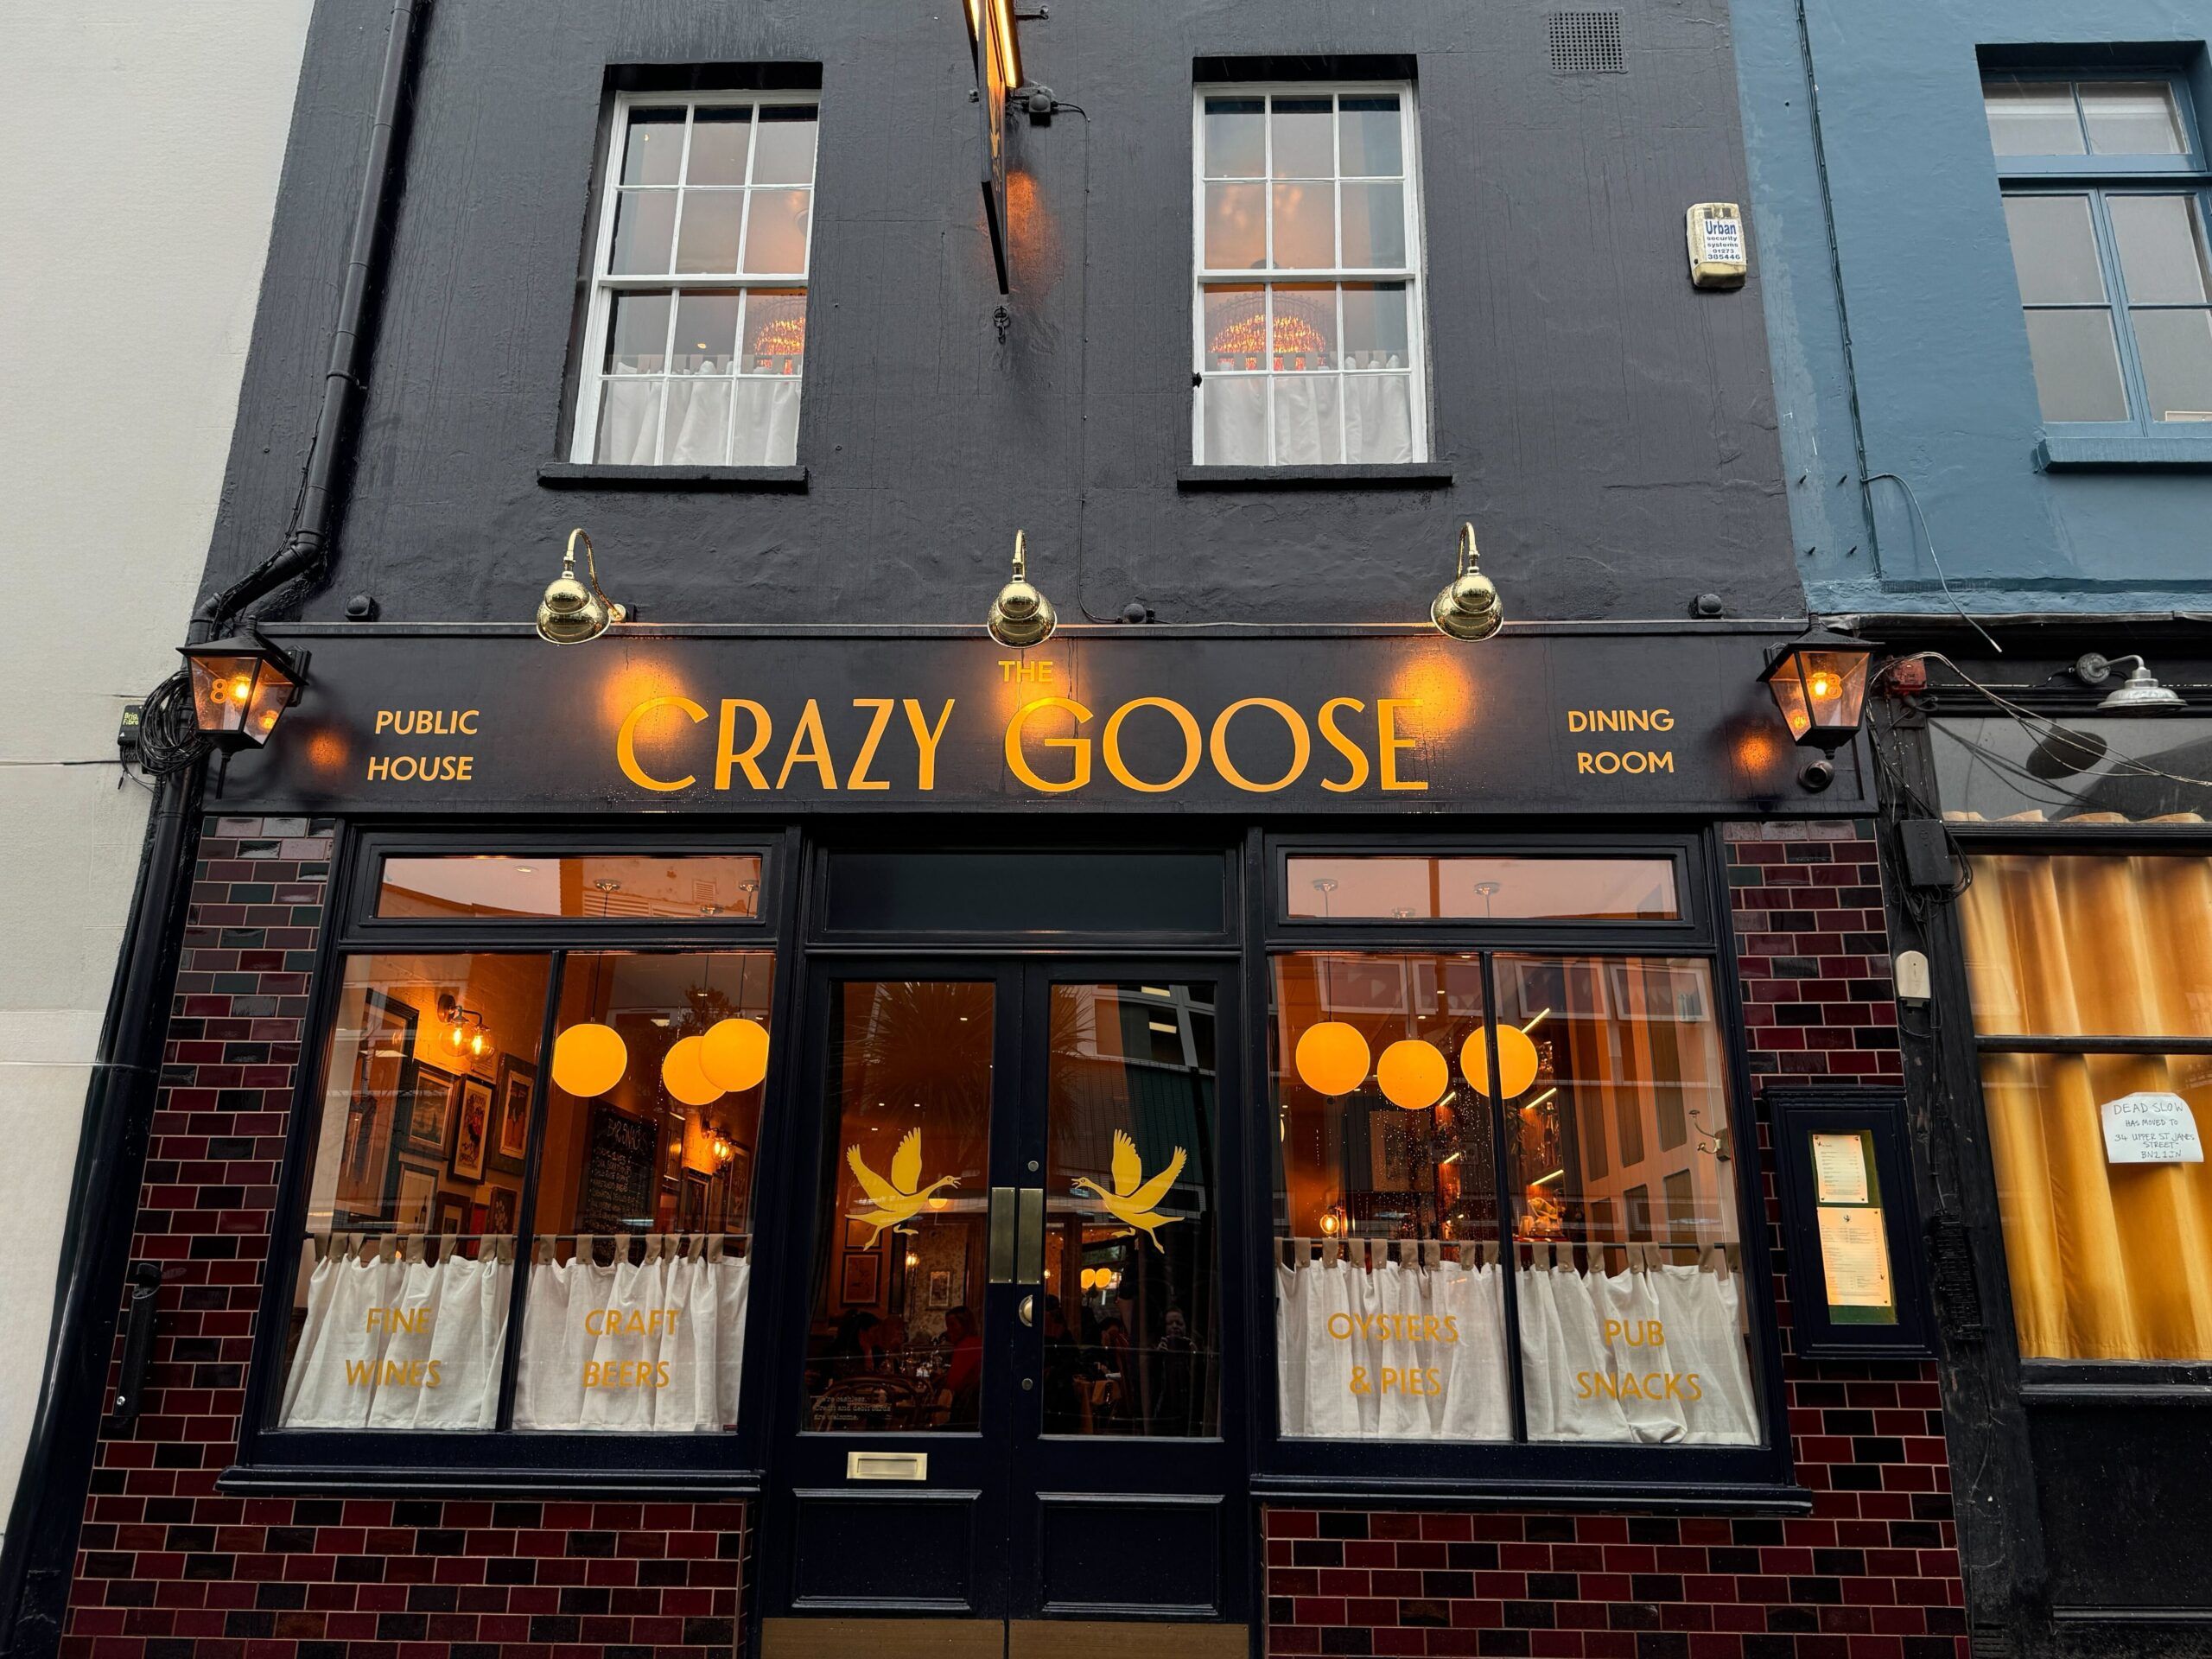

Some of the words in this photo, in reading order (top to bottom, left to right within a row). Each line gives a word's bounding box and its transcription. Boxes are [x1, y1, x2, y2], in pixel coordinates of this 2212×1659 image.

[1705, 220, 1737, 235] Urban
[998, 660, 1054, 683] THE
[211, 679, 227, 703] 8
[374, 710, 480, 734] PUBLIC
[1567, 709, 1675, 733] DINING
[616, 696, 956, 791] CRAZY
[1004, 696, 1429, 793] GOOSE
[367, 756, 474, 781] HOUSE
[1577, 751, 1675, 774] ROOM
[2113, 1103, 2149, 1115] DEAD
[2152, 1102, 2183, 1113] SLOW
[2126, 1119, 2140, 1128] HAS
[2158, 1132, 2170, 1141] ST
[2171, 1133, 2195, 1141] JAMES
[365, 1307, 432, 1334] FINE
[585, 1310, 679, 1335] CRAFT
[1327, 1313, 1459, 1344] OYSTERS
[1605, 1319, 1665, 1347] PUB
[346, 1359, 442, 1388] WINES
[582, 1361, 671, 1388] BEERS
[1349, 1366, 1372, 1394] &
[1381, 1367, 1441, 1396] PIES
[1577, 1370, 1703, 1401] SNACKS
